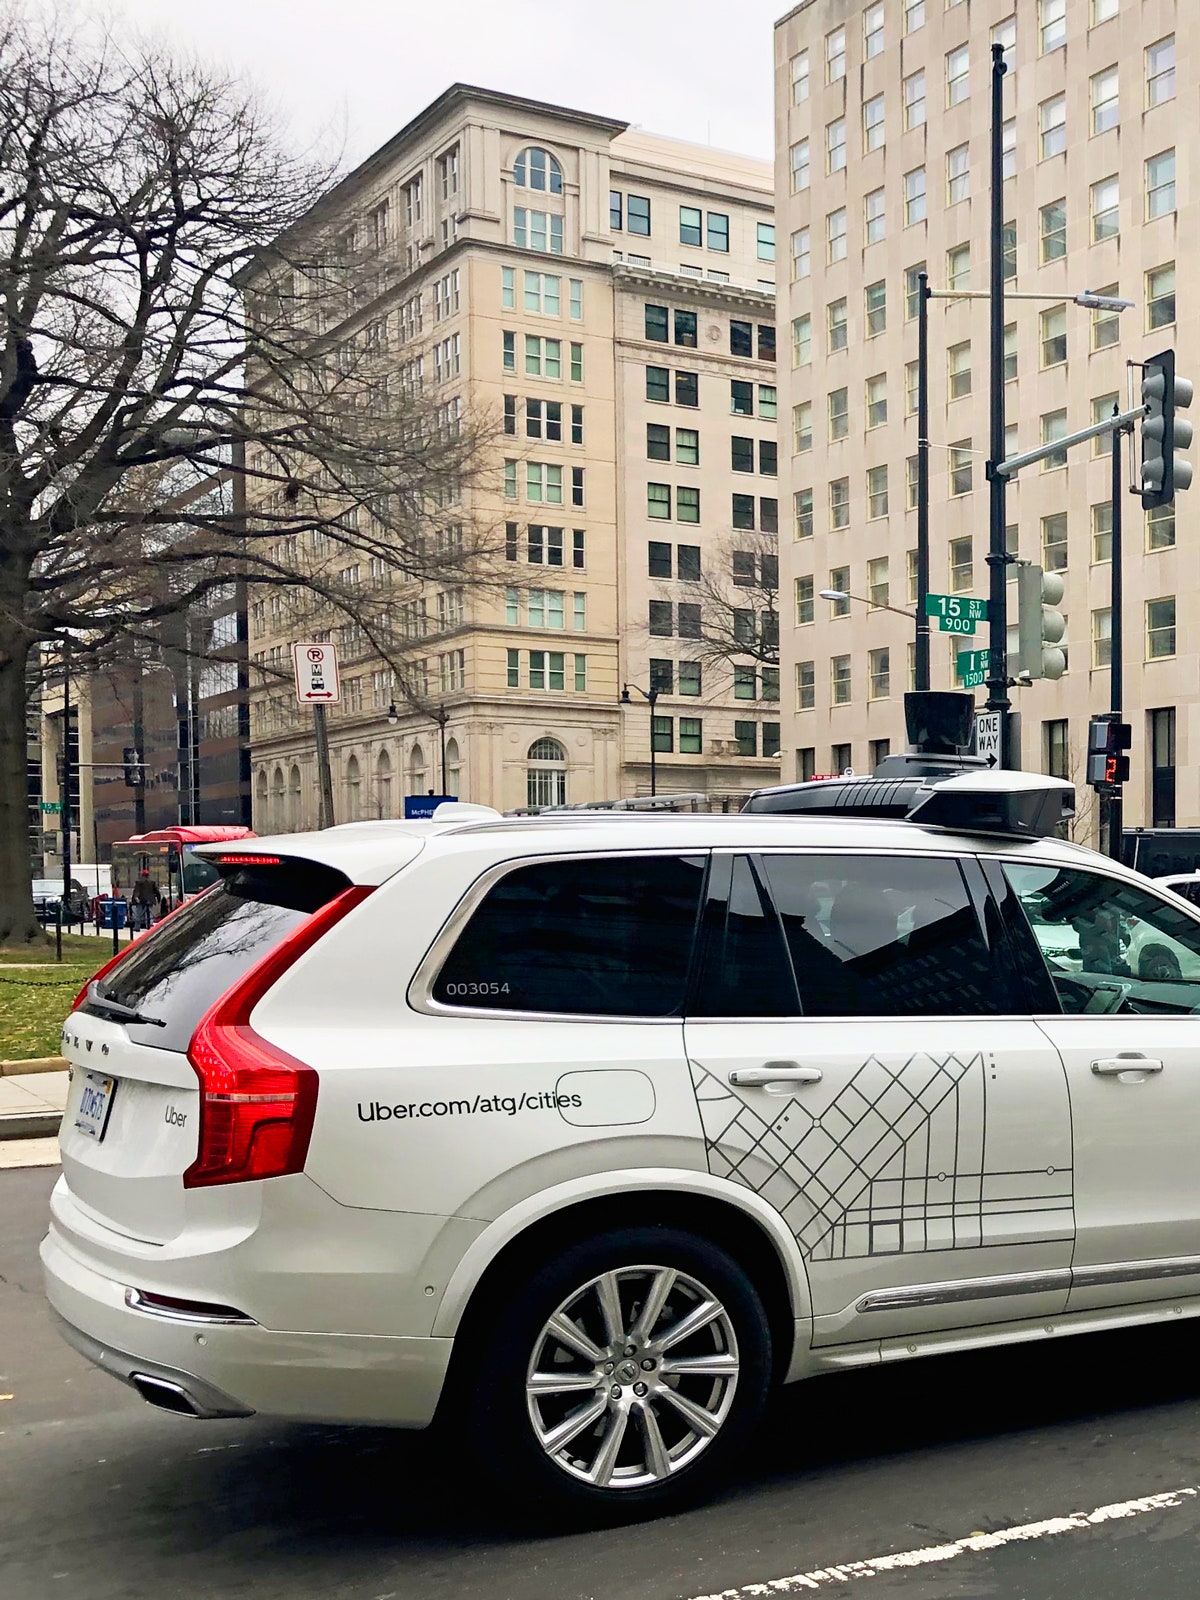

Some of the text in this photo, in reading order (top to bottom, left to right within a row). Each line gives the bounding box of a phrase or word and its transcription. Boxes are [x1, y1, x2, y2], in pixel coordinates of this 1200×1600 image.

[938, 597, 961, 617] 15
[969, 600, 981, 610] ST
[969, 609, 982, 619] NW
[945, 618, 970, 632] 900
[970, 653, 975, 671] I
[981, 651, 988, 660] ST
[312, 664, 322, 674] M
[980, 660, 989, 669] NW
[965, 672, 983, 686] 1500
[980, 717, 998, 733] ONE
[979, 735, 998, 751] WAY
[446, 982, 510, 996] 003054
[357, 1091, 583, 1122] Uber.com/atg/cities
[164, 1105, 188, 1128] Uber
